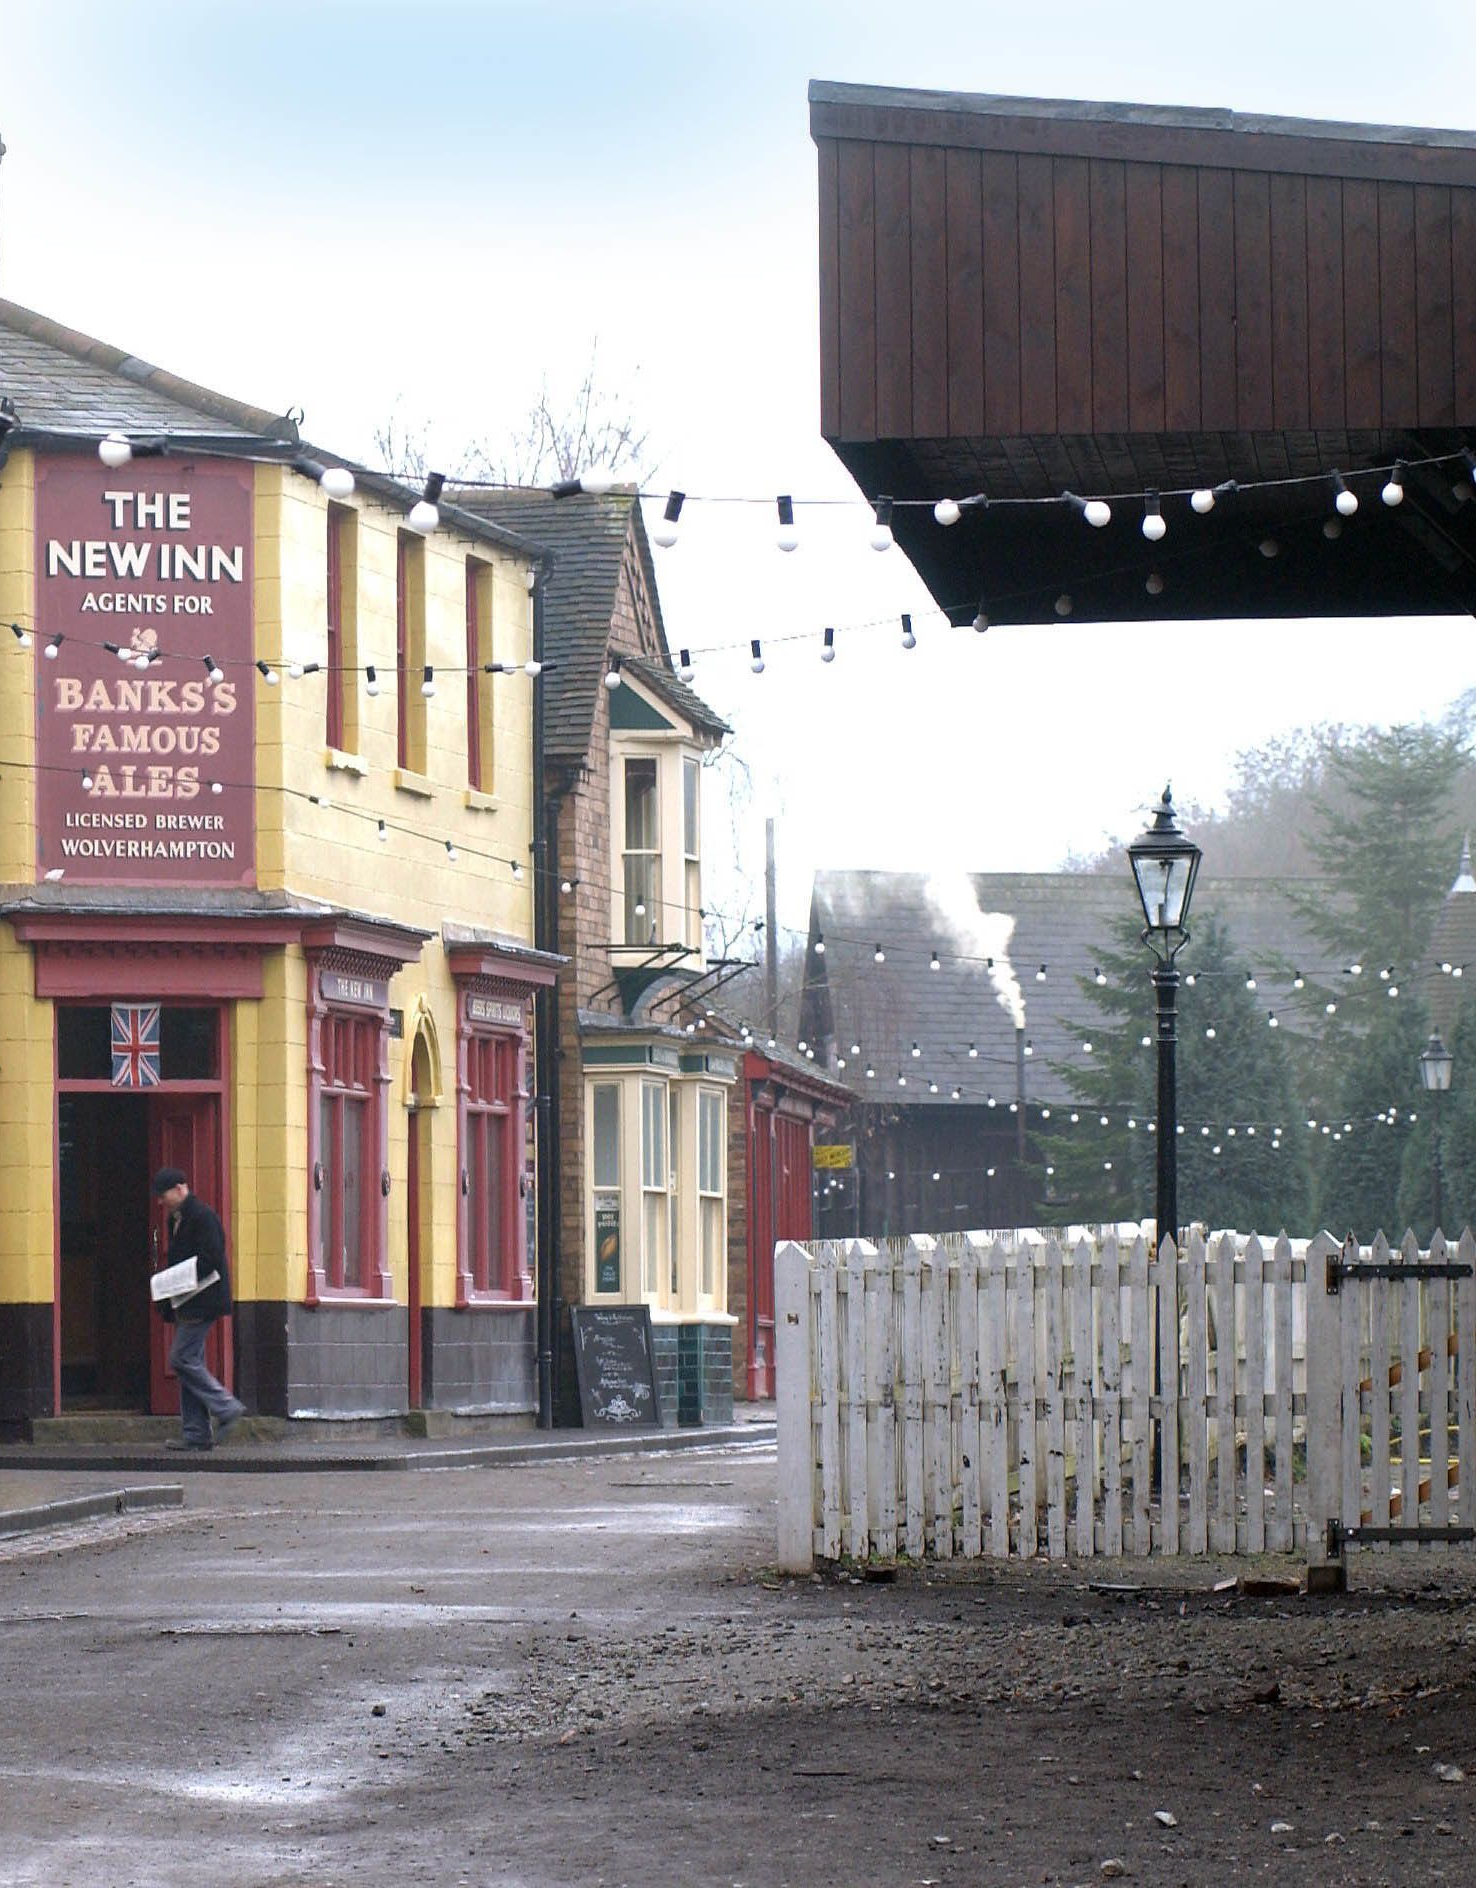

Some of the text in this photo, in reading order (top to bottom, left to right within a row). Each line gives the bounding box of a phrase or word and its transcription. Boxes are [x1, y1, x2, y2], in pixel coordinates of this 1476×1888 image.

[104, 490, 191, 529] THE
[48, 539, 243, 582] NEW INN
[80, 592, 214, 615] AGENTS FOR
[55, 677, 238, 716] BANKS'S
[72, 723, 221, 755] FAMOUS
[89, 763, 201, 799] ALES
[66, 812, 224, 831] LICENSED BREWER
[61, 838, 235, 859] WOLVERHAMPTON
[337, 977, 373, 1002] THE NEW INN
